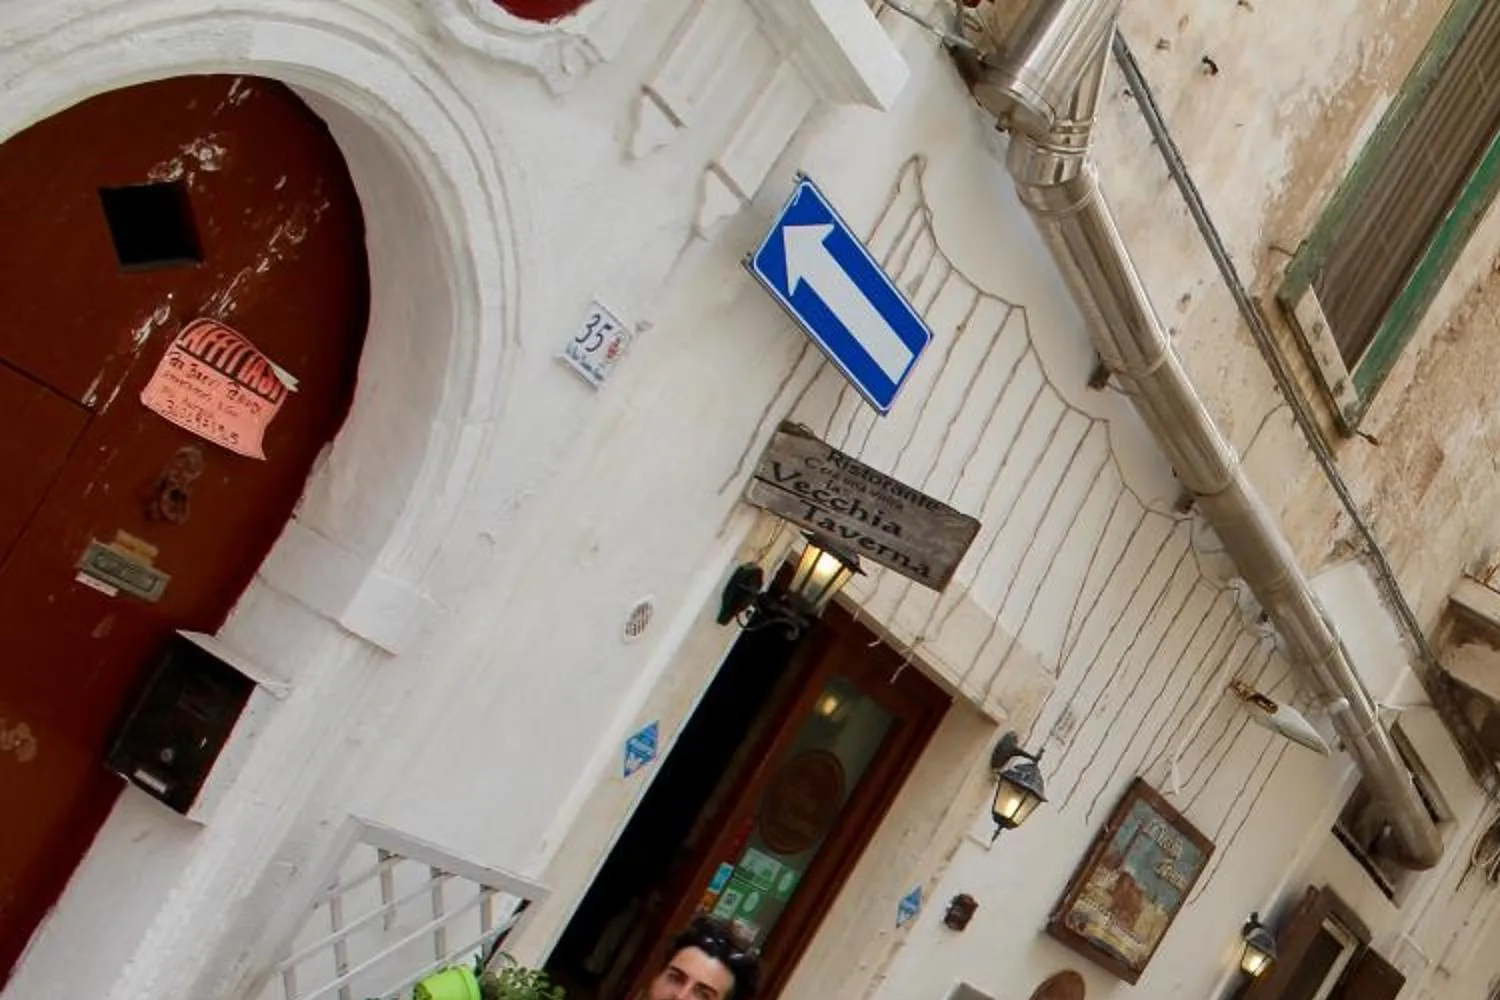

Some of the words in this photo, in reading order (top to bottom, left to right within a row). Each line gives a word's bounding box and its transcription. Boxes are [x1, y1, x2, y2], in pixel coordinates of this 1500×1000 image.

[574, 313, 613, 353] 35
[772, 461, 903, 538] Vecchia
[828, 449, 938, 513] Ristorante
[801, 499, 931, 578] Taverna
